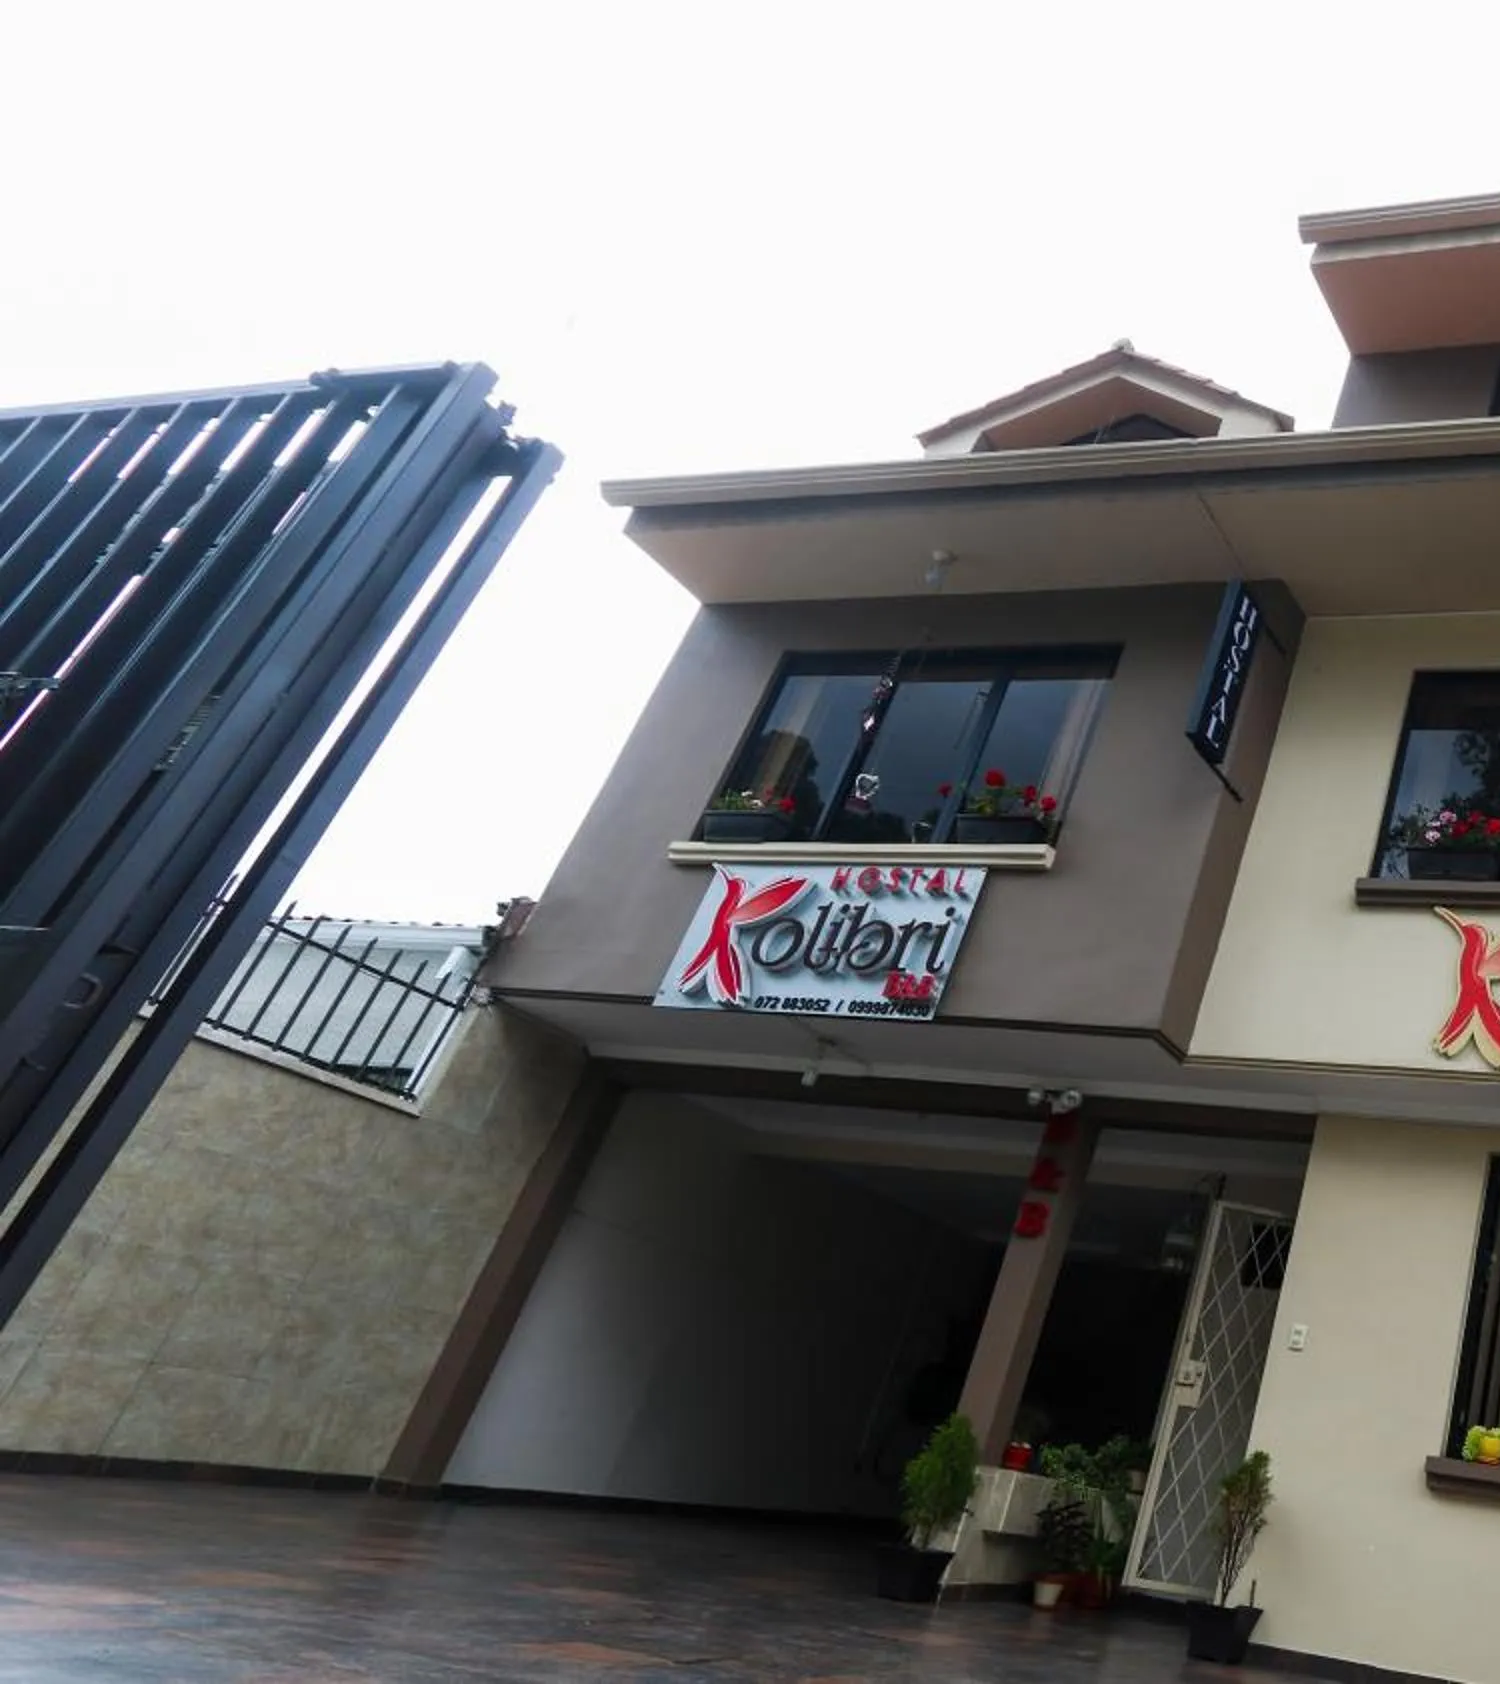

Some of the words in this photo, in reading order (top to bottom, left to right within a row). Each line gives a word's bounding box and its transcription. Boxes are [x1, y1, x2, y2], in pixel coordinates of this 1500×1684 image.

[1206, 597, 1258, 749] HOSTAL
[830, 866, 968, 895] HOSTAL
[678, 862, 957, 1007] Kolibri
[753, 995, 781, 1010] 072
[834, 998, 845, 1013] /
